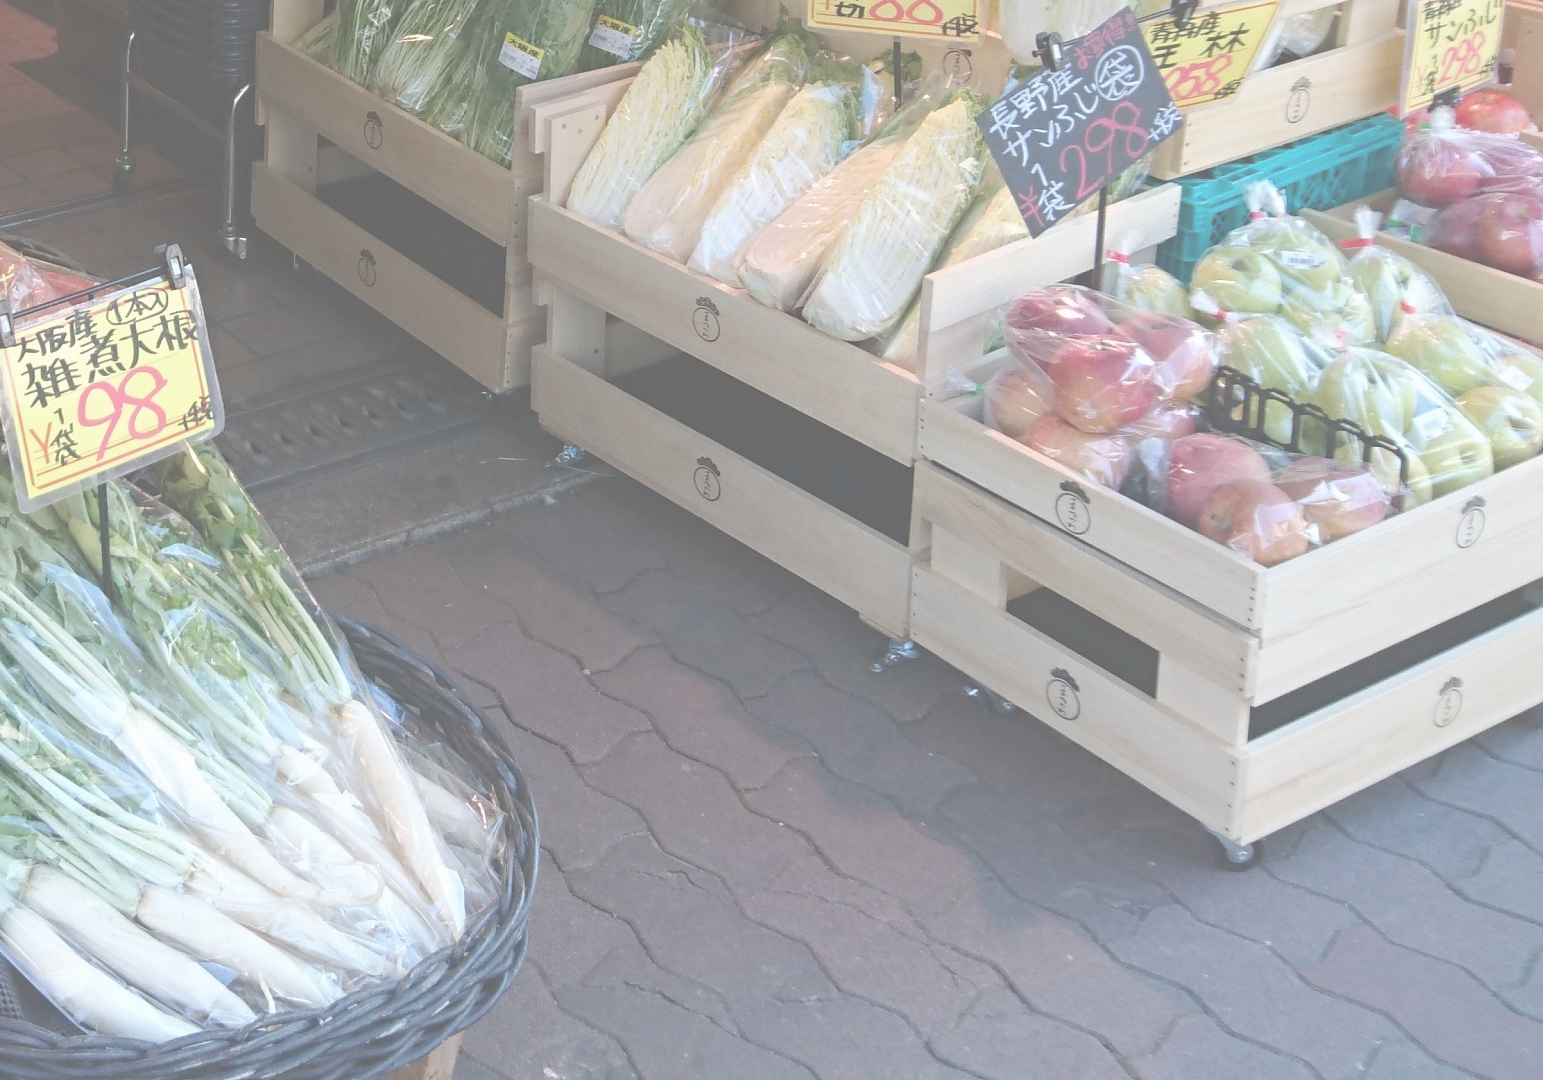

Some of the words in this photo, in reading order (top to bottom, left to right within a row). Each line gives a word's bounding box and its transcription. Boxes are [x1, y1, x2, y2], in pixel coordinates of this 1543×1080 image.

[1152, 21, 1250, 68] 王林
[1437, 30, 1486, 86] 298
[988, 61, 1084, 138] 長野産
[1001, 81, 1100, 168] サンふじ
[1058, 101, 1150, 202] 298
[13, 308, 99, 363] 大阪産
[20, 308, 200, 410] 雑煮大根
[77, 365, 169, 462] 98
